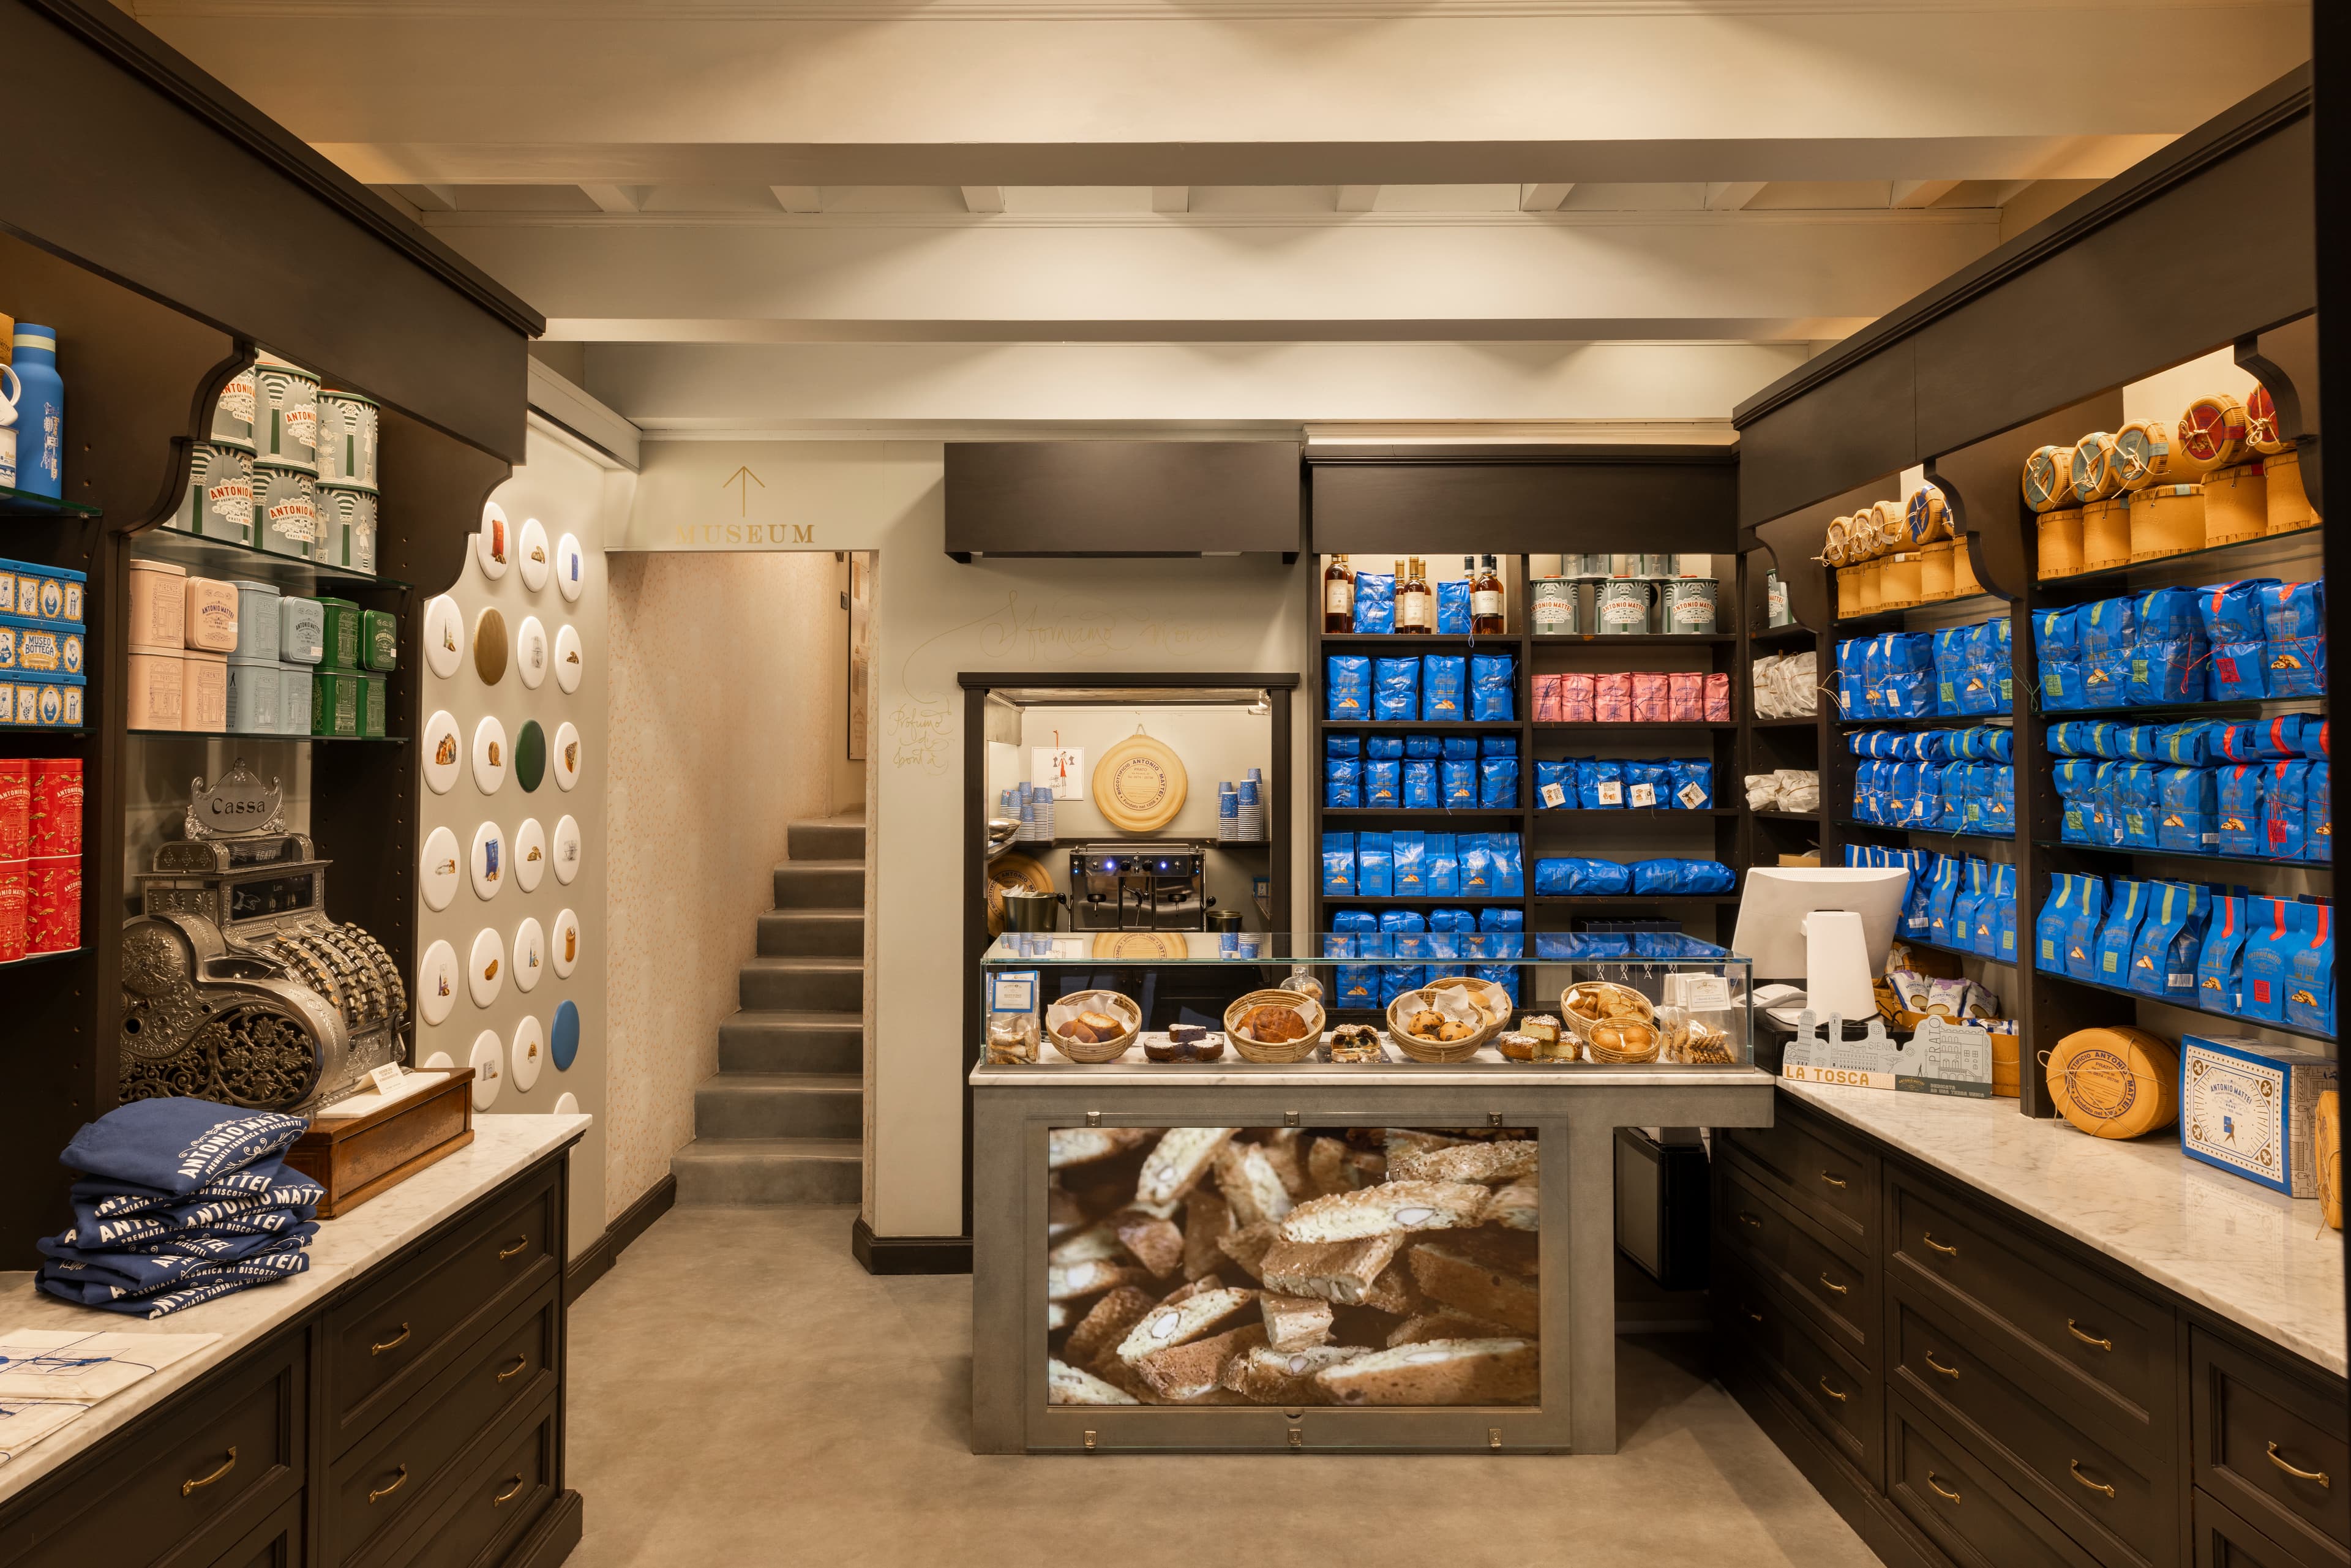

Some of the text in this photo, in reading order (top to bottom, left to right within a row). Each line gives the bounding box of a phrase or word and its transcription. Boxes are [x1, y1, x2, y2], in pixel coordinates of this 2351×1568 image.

[0, 338, 10, 352] ATTEI
[210, 486, 249, 500] ANTONIO
[270, 505, 307, 519] ANTONIO
[675, 524, 815, 544] MUSEUM
[159, 583, 178, 593] FIRENZE
[202, 605, 234, 618] ANTONIO MATTEI
[1531, 602, 1572, 612] ANTONIO MATTEI
[1602, 602, 1645, 613] ANTONIO MATTEI
[1673, 601, 1715, 613] ANTONIO MATTEI
[296, 622, 310, 631] ANTONIO
[29, 636, 51, 647] MUSEO
[25, 644, 54, 656] BOTTEGA
[888, 703, 953, 739] Profumo
[1116, 763, 1130, 795] BISCOTTIFICIO
[1133, 759, 1159, 771] ANTONIO
[57, 788, 78, 797] ANTONIO
[212, 798, 265, 814] Cassa
[1123, 798, 1138, 809] Fondato
[1002, 871, 1028, 883] ANTONIO
[12, 889, 26, 898] MATTEI
[2267, 953, 2282, 965] MATTEI
[1869, 1041, 1894, 1052] SIENA
[1929, 1018, 1941, 1062] PRATO
[1785, 1045, 1798, 1063] PISA
[1787, 1066, 1805, 1079] LA
[2095, 1062, 2113, 1070] PRATO
[2094, 1052, 2128, 1075] ANTONIO
[2122, 1079, 2133, 1109] MATTEI
[2211, 1084, 2233, 1092] ANTONIO
[2234, 1087, 2252, 1105] MATTEI
[2074, 1095, 2093, 1113] Fondato
[178, 1113, 304, 1179] ANTONIO MATT
[205, 1149, 231, 1175] PREMIATA
[230, 1131, 260, 1149] FABBRICA
[270, 1120, 301, 1130] BISCOTTI
[216, 1175, 272, 1193] ATTEI
[187, 1189, 324, 1227] ANTONIO MATT
[99, 1219, 160, 1243] ANTO
[121, 1226, 165, 1244] PREMIATA
[227, 1223, 262, 1234] BISCOTT
[175, 1240, 207, 1257] BISCOTTI
[239, 1266, 278, 1276] BISCOTTI
[208, 1280, 243, 1296] FABBRICA
